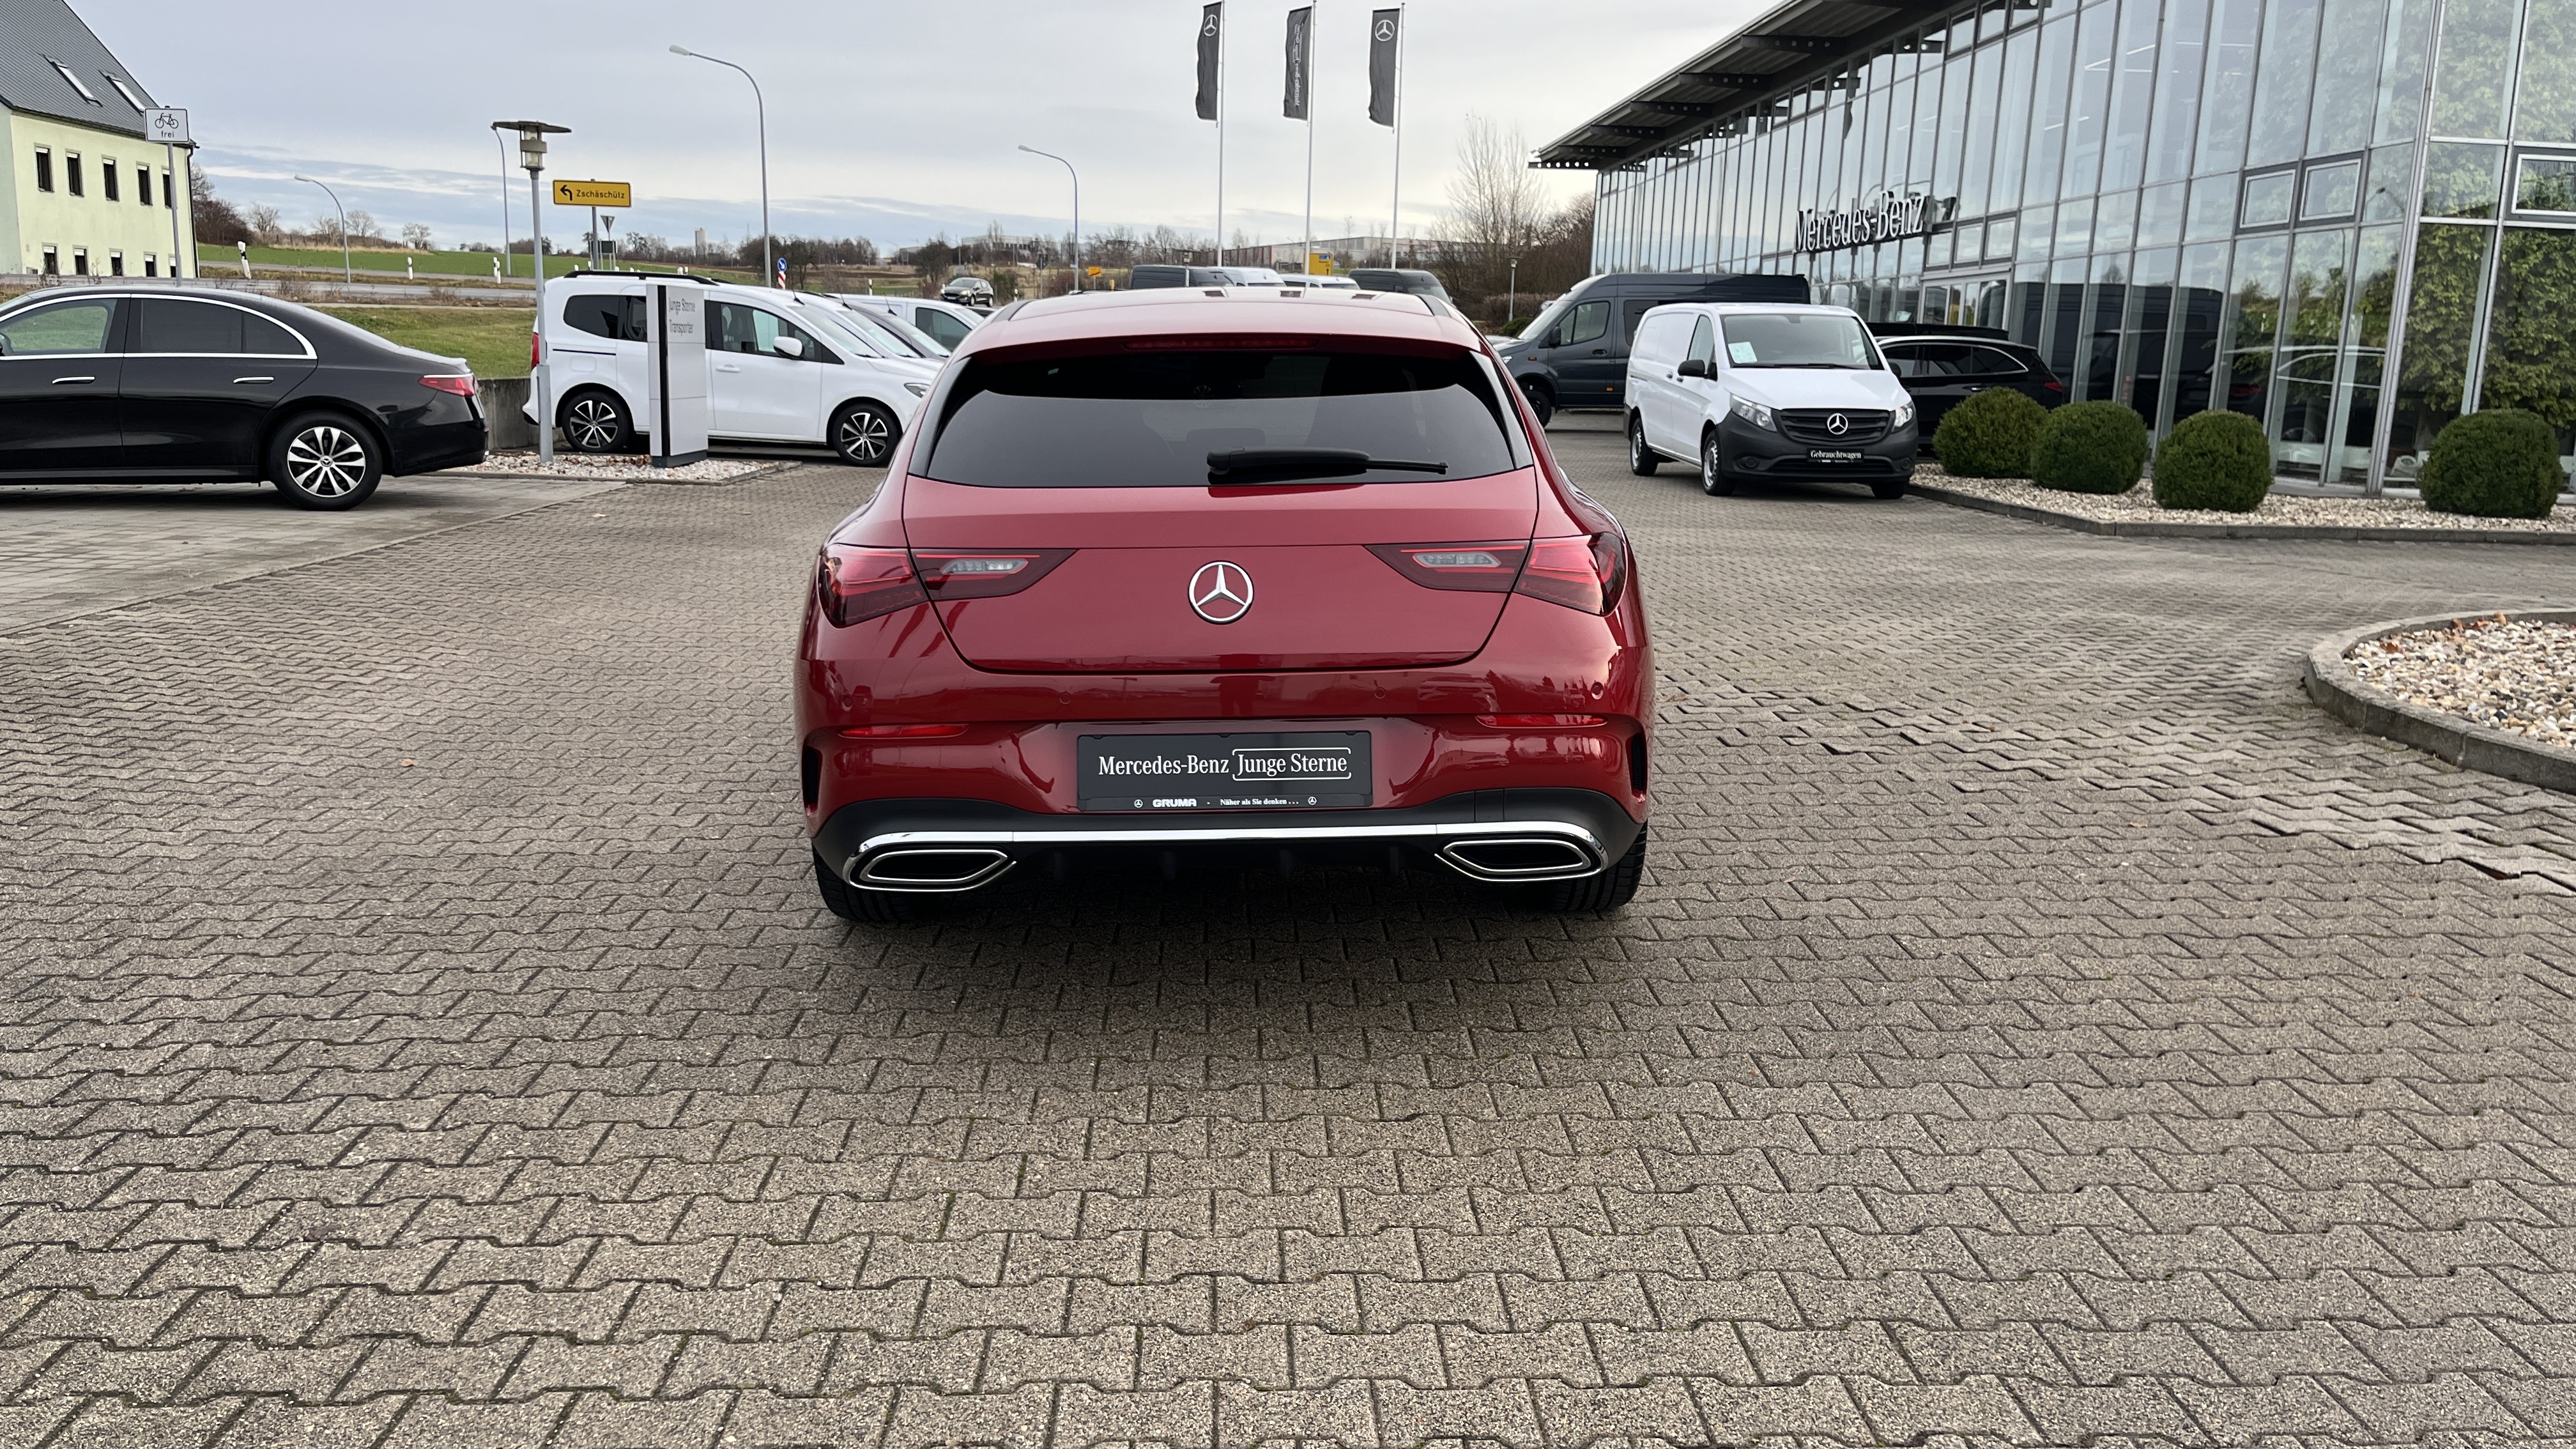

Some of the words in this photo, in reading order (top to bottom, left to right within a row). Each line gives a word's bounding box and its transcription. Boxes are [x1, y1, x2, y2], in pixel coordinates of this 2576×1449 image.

[576, 189, 625, 199] Zschäschütz
[1795, 189, 1925, 252] Mercedes-Benz
[1810, 450, 1862, 460] Gebrauchtwagen
[1098, 755, 1229, 775] Mercedes-Benz
[1237, 754, 1286, 777] Junge
[1290, 753, 1347, 772] Sterne
[1153, 798, 1197, 808] GRUMA
